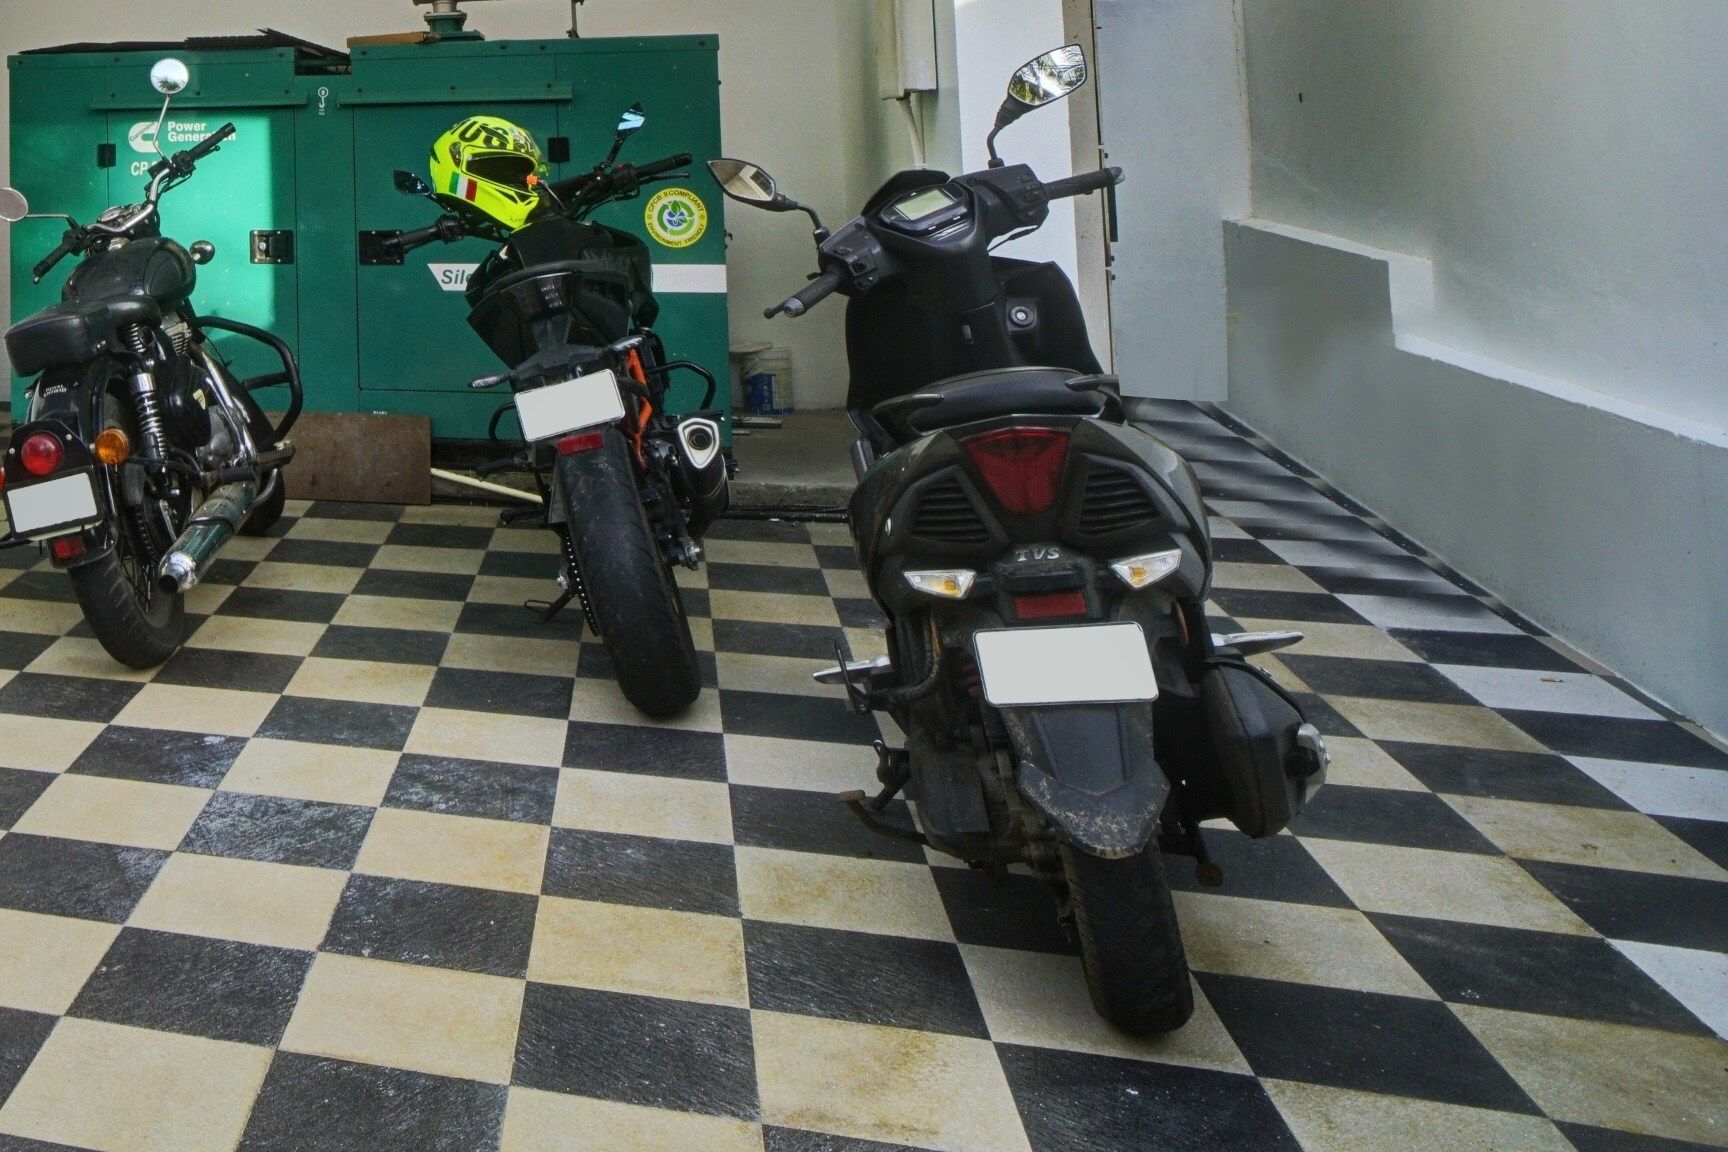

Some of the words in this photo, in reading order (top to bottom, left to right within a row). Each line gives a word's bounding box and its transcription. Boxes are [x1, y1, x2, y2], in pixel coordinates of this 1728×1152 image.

[168, 121, 206, 132] Power
[131, 161, 148, 176] CP
[669, 190, 704, 212] COMPLIANT
[1015, 548, 1059, 562] TVS
